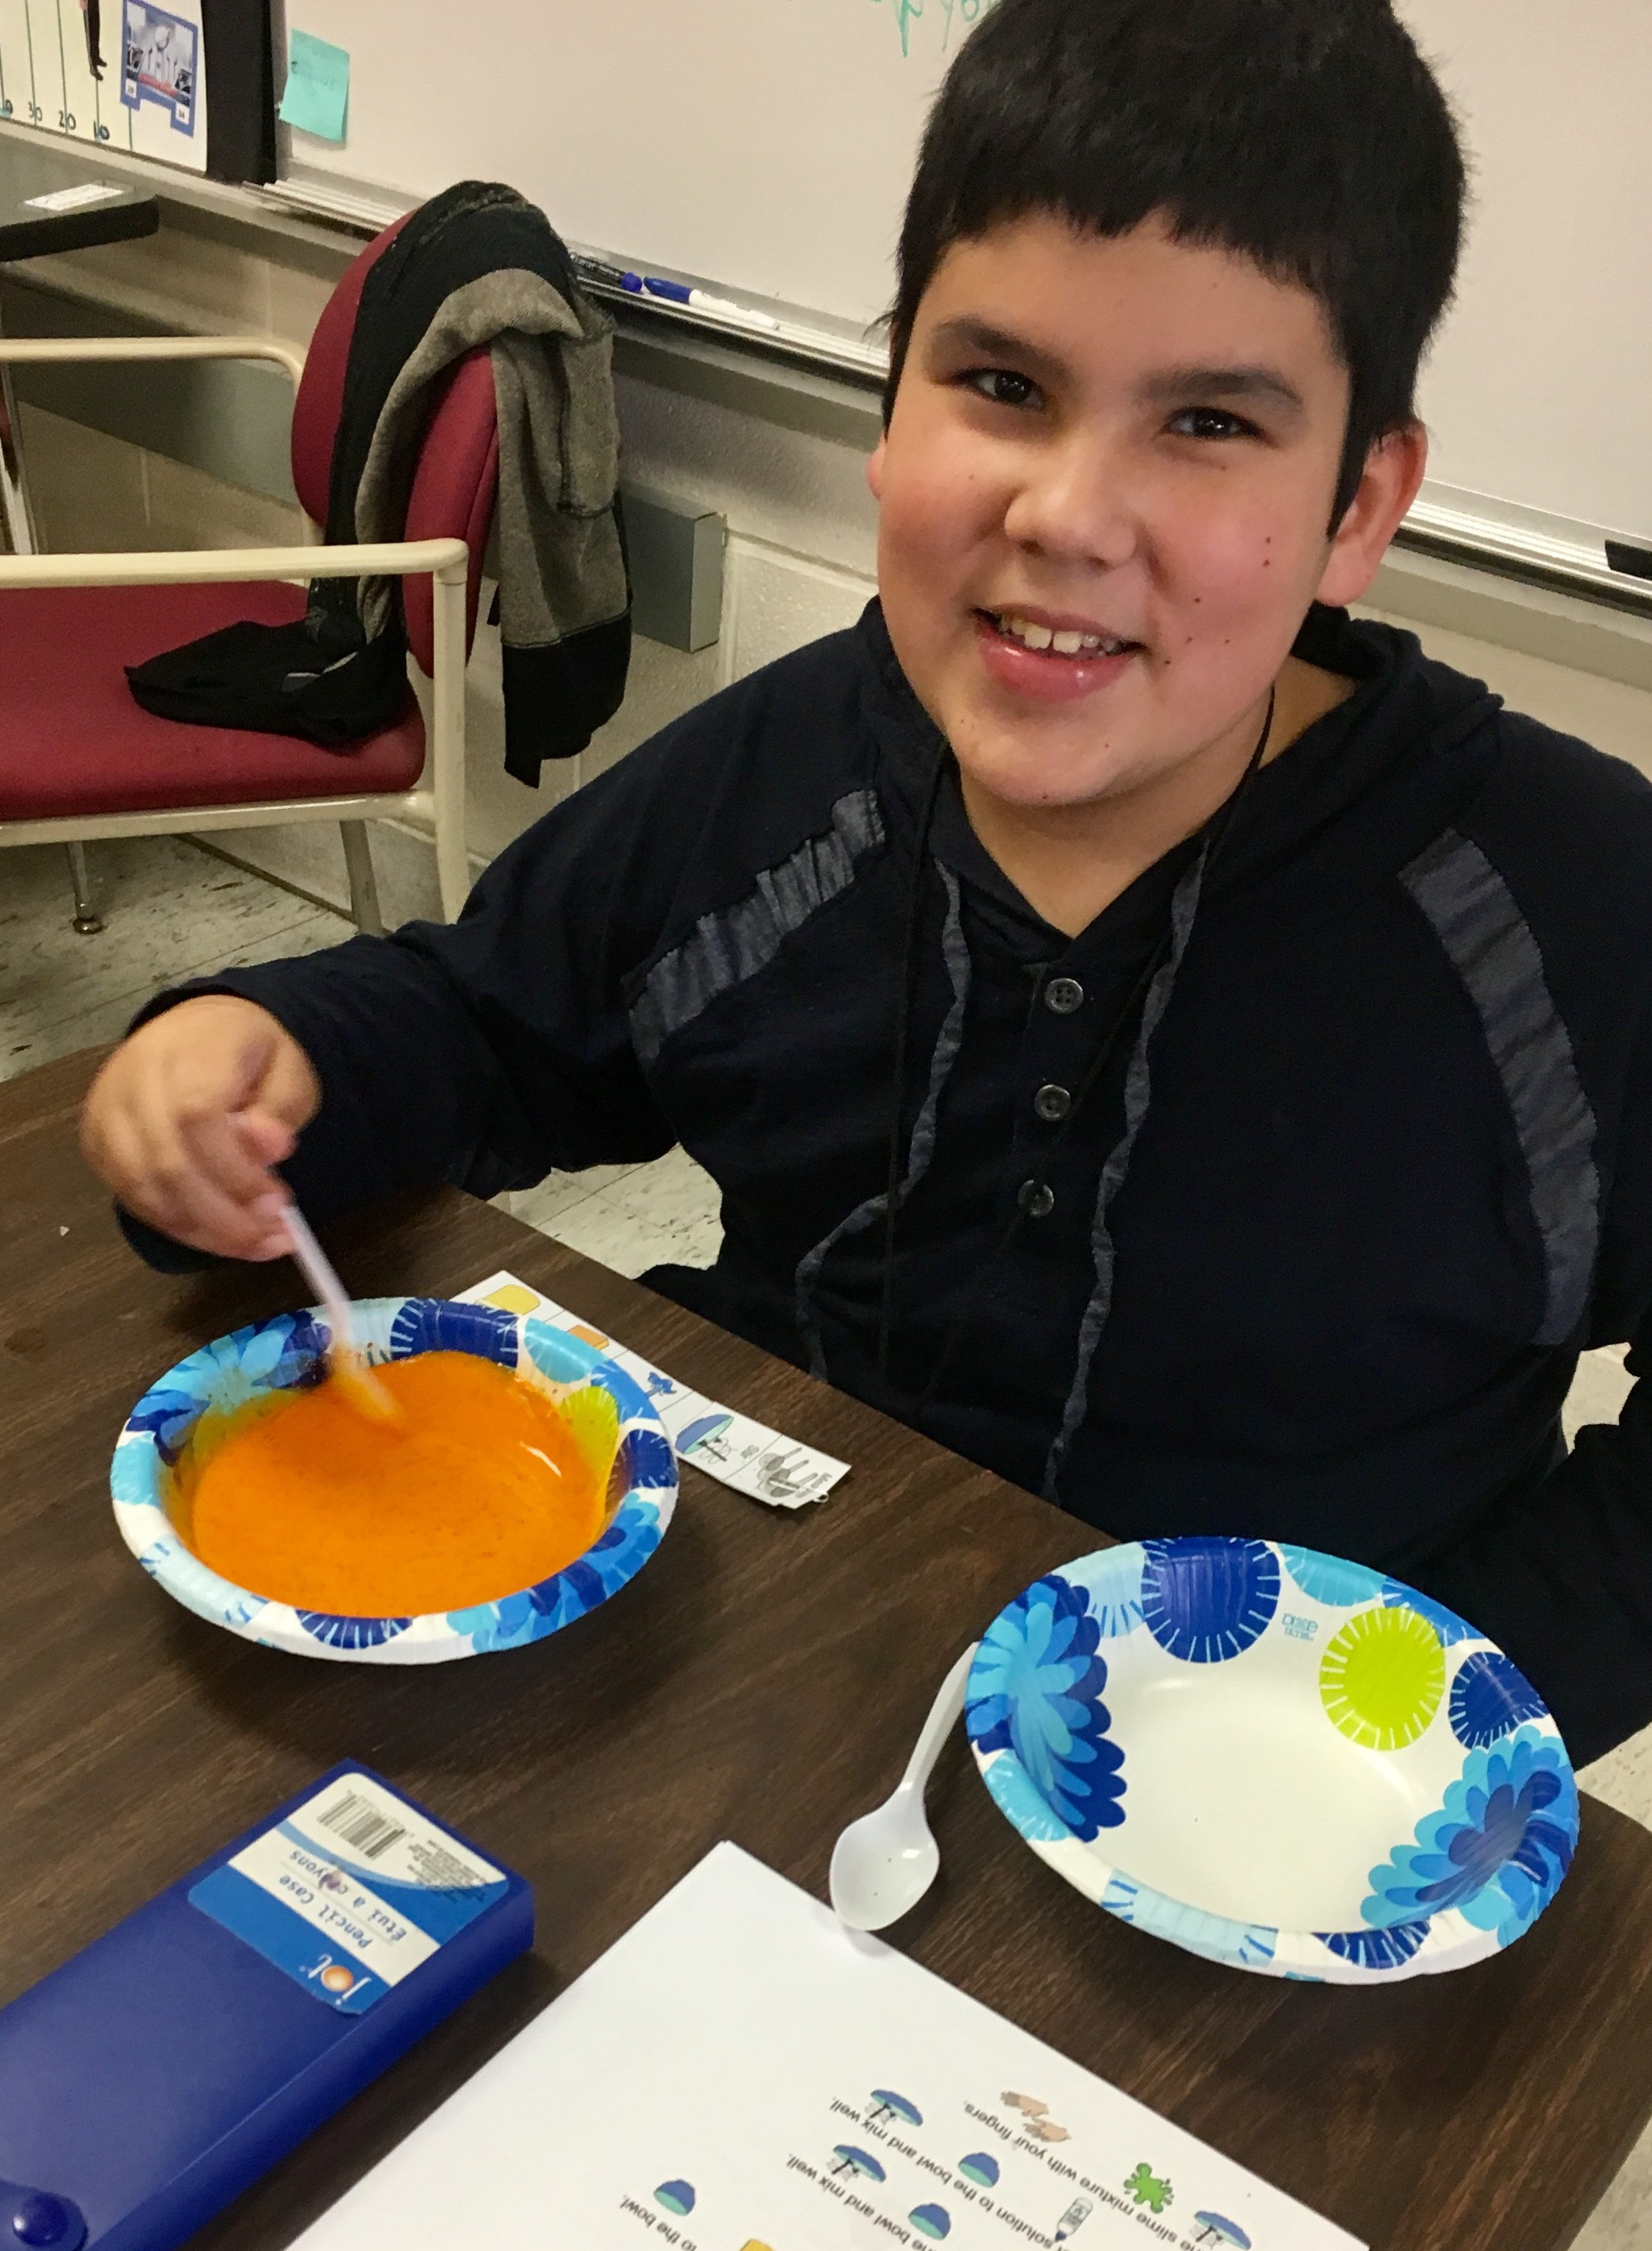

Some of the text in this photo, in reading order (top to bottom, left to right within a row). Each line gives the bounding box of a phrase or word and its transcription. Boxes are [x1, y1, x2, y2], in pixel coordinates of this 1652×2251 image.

[28, 101, 43, 122] 30
[59, 110, 76, 130] 20
[93, 121, 110, 140] 10
[290, 1850, 348, 1895] cyons
[279, 1875, 373, 1949] Pencil Case
[308, 1954, 372, 2006] jot
[829, 2096, 861, 2123] well.
[964, 2101, 1014, 2140] fingers.
[861, 2118, 889, 2140] mix
[886, 2137, 918, 2158] and
[1015, 2136, 1048, 2160] your
[786, 2153, 819, 2180] well.
[916, 2156, 953, 2185] bowl
[1047, 2156, 1077, 2181] with
[818, 2176, 846, 2199] mix
[954, 2178, 978, 2202] the
[1080, 2178, 1135, 2217] mixture
[619, 2195, 657, 2228] bowl.
[843, 2195, 875, 2217] and
[979, 2196, 995, 2212] to
[656, 2222, 681, 2244] the
[873, 2214, 910, 2245] bowl
[996, 2206, 1054, 2249] solution
[1136, 2212, 1178, 2243] slime
